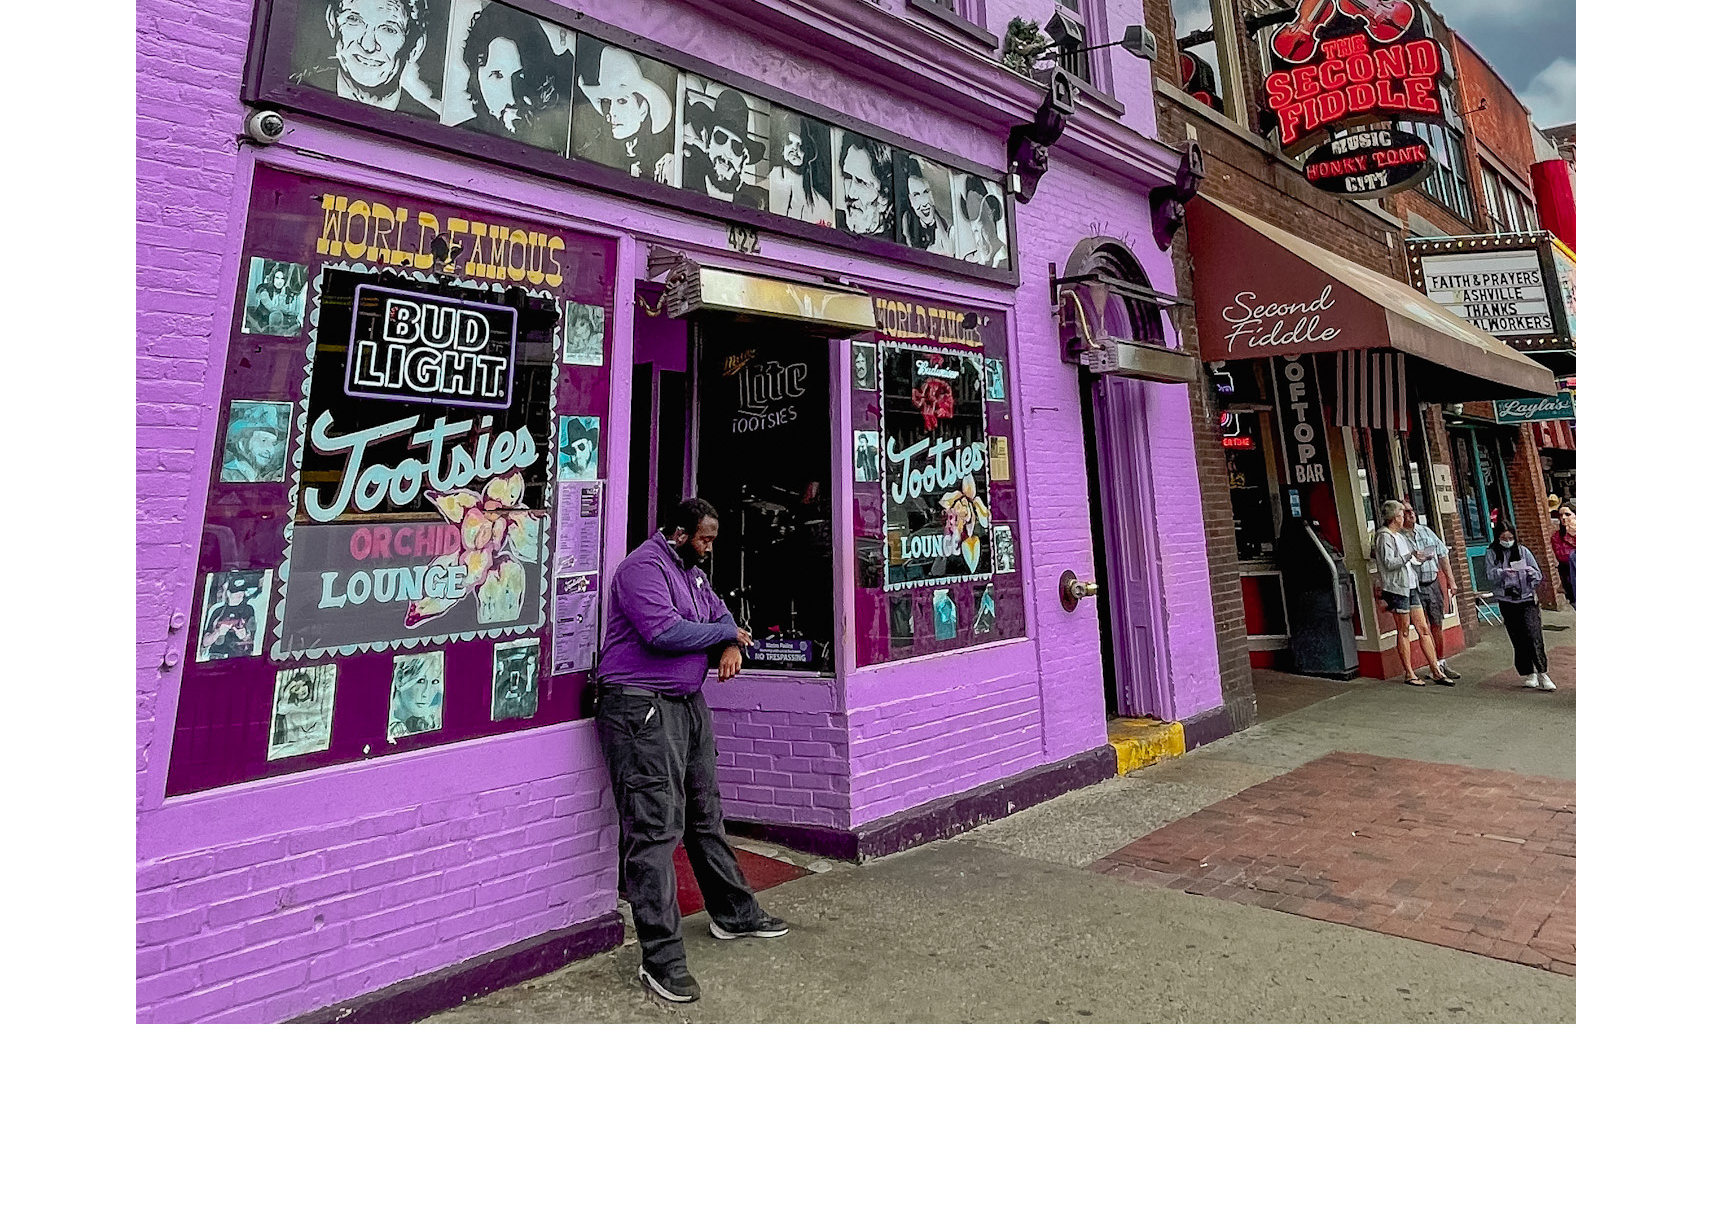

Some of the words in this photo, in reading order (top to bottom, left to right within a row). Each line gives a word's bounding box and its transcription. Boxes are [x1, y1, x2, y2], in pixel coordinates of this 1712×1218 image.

[1321, 34, 1369, 60] THE
[1265, 39, 1440, 110] SECOND
[1276, 77, 1440, 144] FIDDLE
[1332, 131, 1392, 155] MUSIC
[1306, 154, 1368, 181] HONKY
[1372, 144, 1427, 168] TONK
[1345, 170, 1388, 192] CITY
[316, 193, 439, 269] WORLD
[443, 217, 566, 287] FAMOUS
[1431, 274, 1470, 289] FAITH
[1483, 271, 1540, 286] PRAYERS
[875, 297, 927, 339] WORLD
[1222, 284, 1336, 323] Second
[1464, 302, 1518, 318] THANKS
[382, 298, 490, 352] BUD
[1224, 314, 1342, 352] Fiddle
[354, 340, 507, 397] LIGHT
[738, 361, 807, 418] Lite
[1499, 398, 1572, 418] Layla's
[732, 405, 797, 433] TOOTSIES
[304, 409, 539, 522] Tootsies
[887, 435, 985, 504] Tootsies
[1295, 463, 1325, 483] BAR
[350, 524, 463, 561] ORCHID
[317, 565, 470, 610] LOUNGE
[766, 653, 807, 662] TRESPASSING
